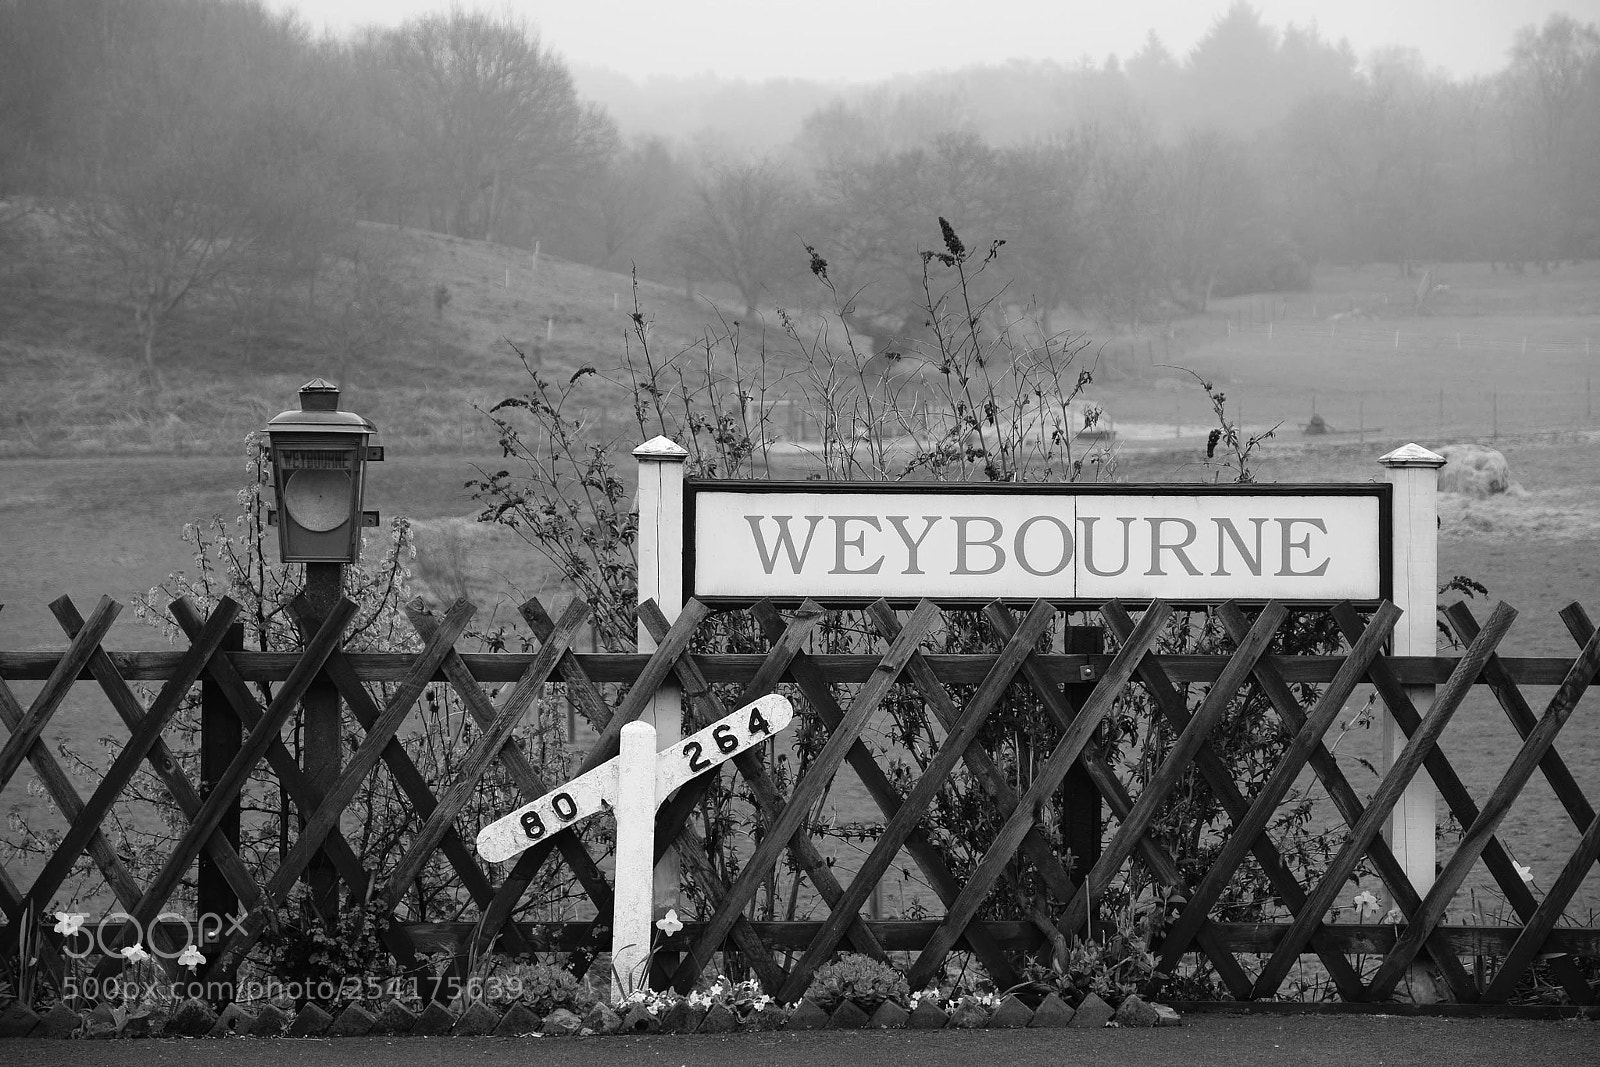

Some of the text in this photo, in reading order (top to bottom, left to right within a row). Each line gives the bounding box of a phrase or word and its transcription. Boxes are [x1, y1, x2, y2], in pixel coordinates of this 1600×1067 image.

[743, 515, 1332, 577] WEYBOURNE
[520, 707, 773, 839] 80 264
